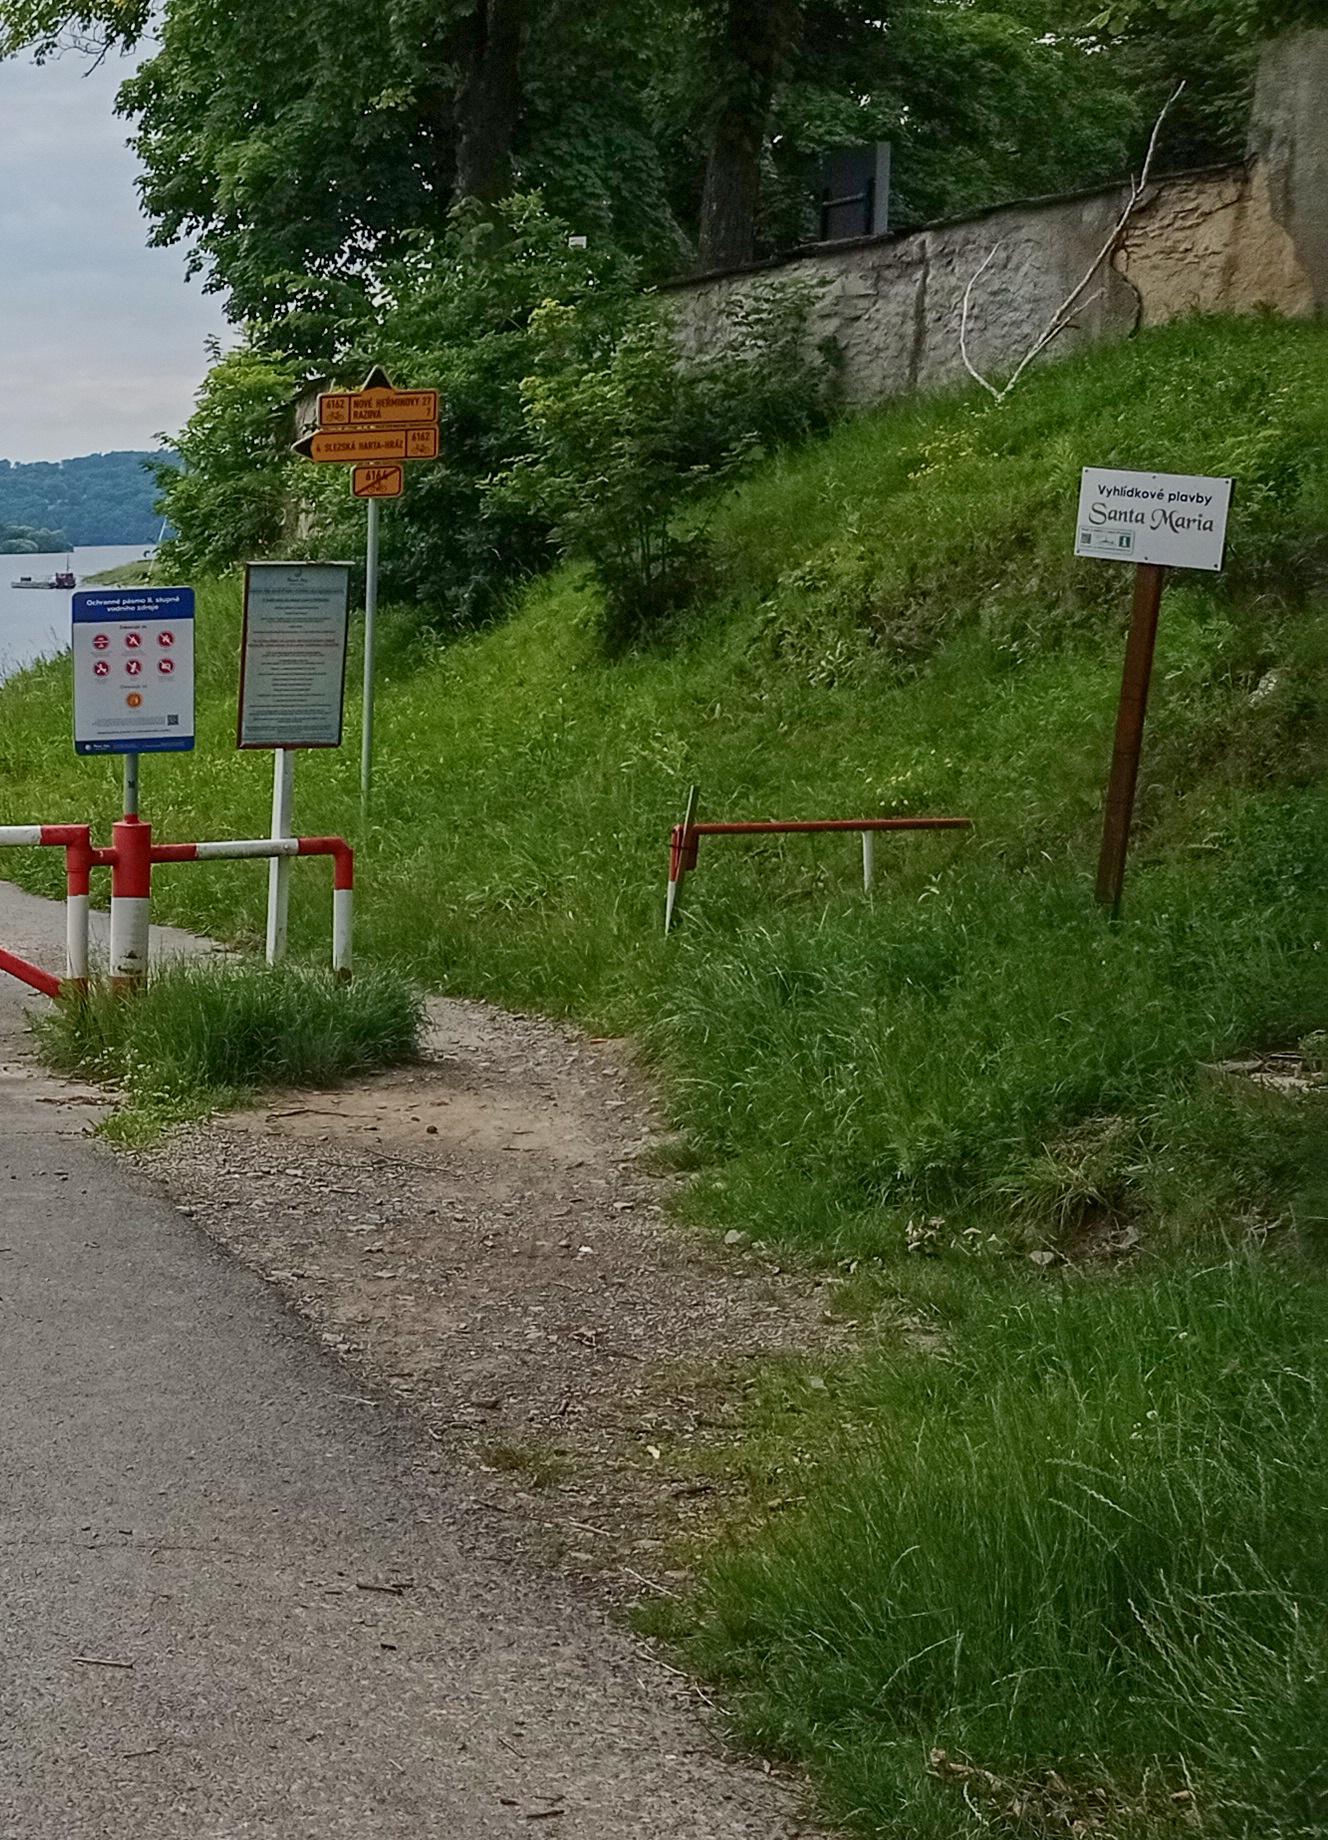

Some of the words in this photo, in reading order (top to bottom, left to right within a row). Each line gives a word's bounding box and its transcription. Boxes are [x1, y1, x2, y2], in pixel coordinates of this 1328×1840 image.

[326, 399, 345, 409] 6162
[353, 396, 373, 409] NOVÉ
[422, 396, 432, 406] 27
[411, 432, 431, 442] 6162
[1098, 484, 1164, 500] Vyhlídkové
[1168, 491, 1212, 506] plavby
[1088, 502, 1145, 525] Santa
[1150, 508, 1213, 534] Maria
